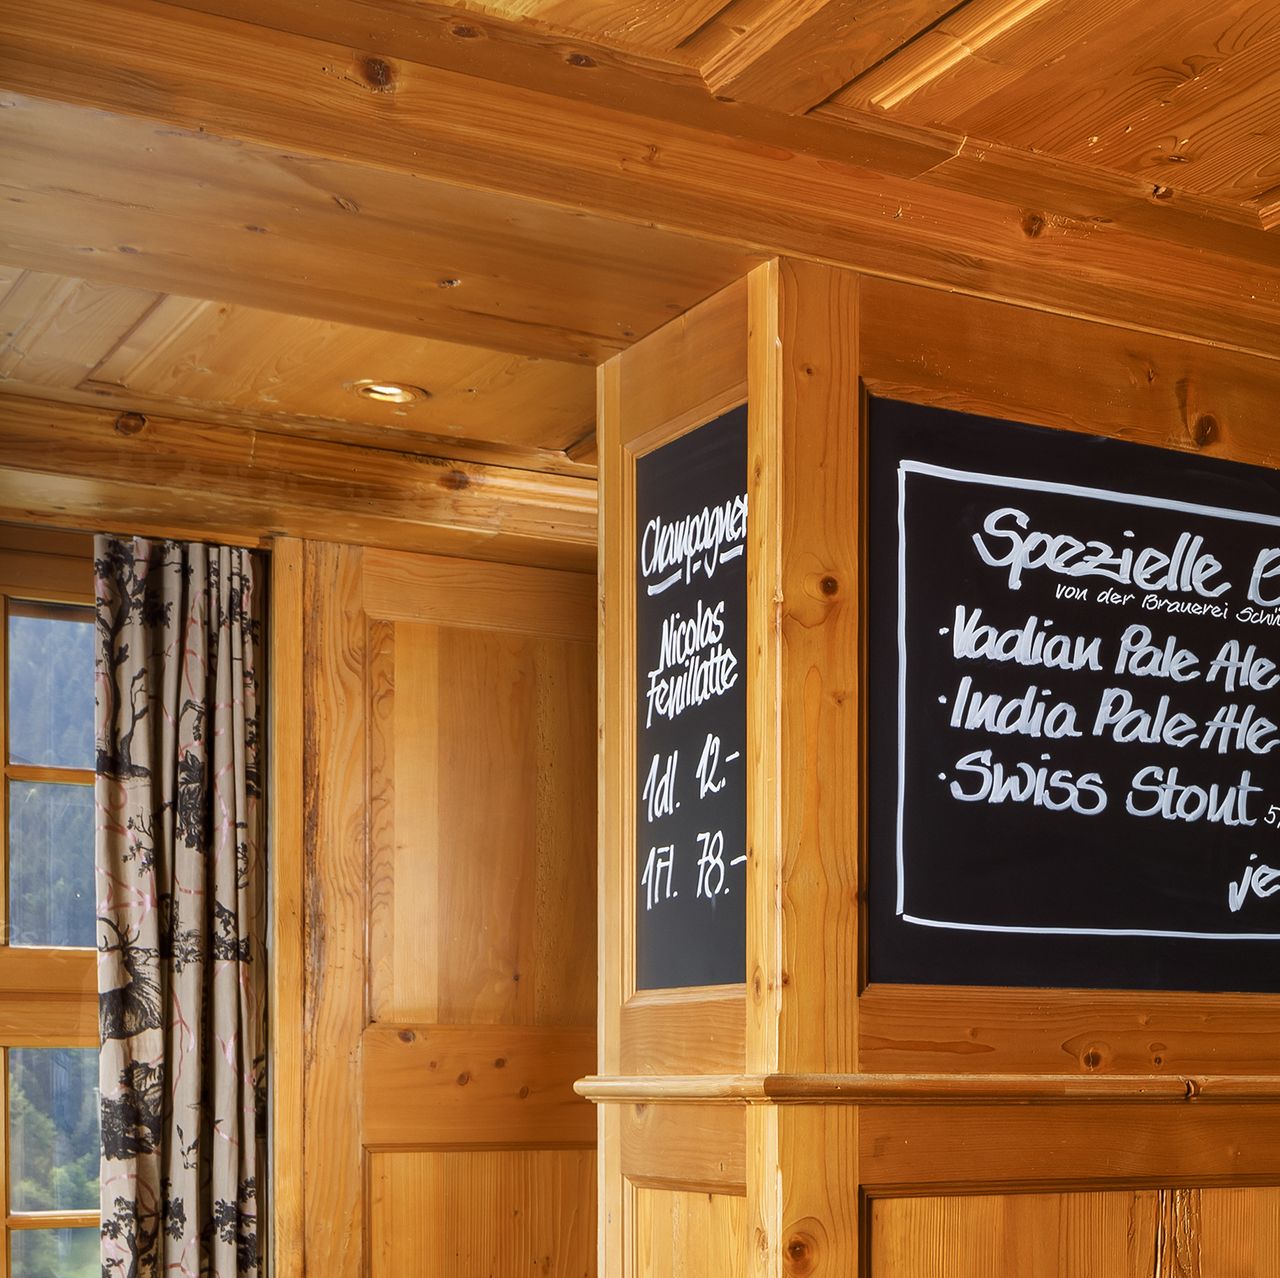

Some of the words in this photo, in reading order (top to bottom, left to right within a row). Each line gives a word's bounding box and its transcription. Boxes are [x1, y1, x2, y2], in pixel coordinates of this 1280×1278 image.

[973, 508, 1231, 598] Spezielle
[659, 599, 725, 673] Nicolas
[1055, 584, 1088, 600] von
[1097, 588, 1136, 605] der
[1142, 594, 1229, 619] Brauerei
[951, 605, 1102, 671] Vadian
[1114, 623, 1202, 682] Pale
[950, 676, 1083, 738] India
[1093, 687, 1200, 748] Pale
[949, 749, 1109, 816] Swiss
[1125, 765, 1264, 827] Stout
